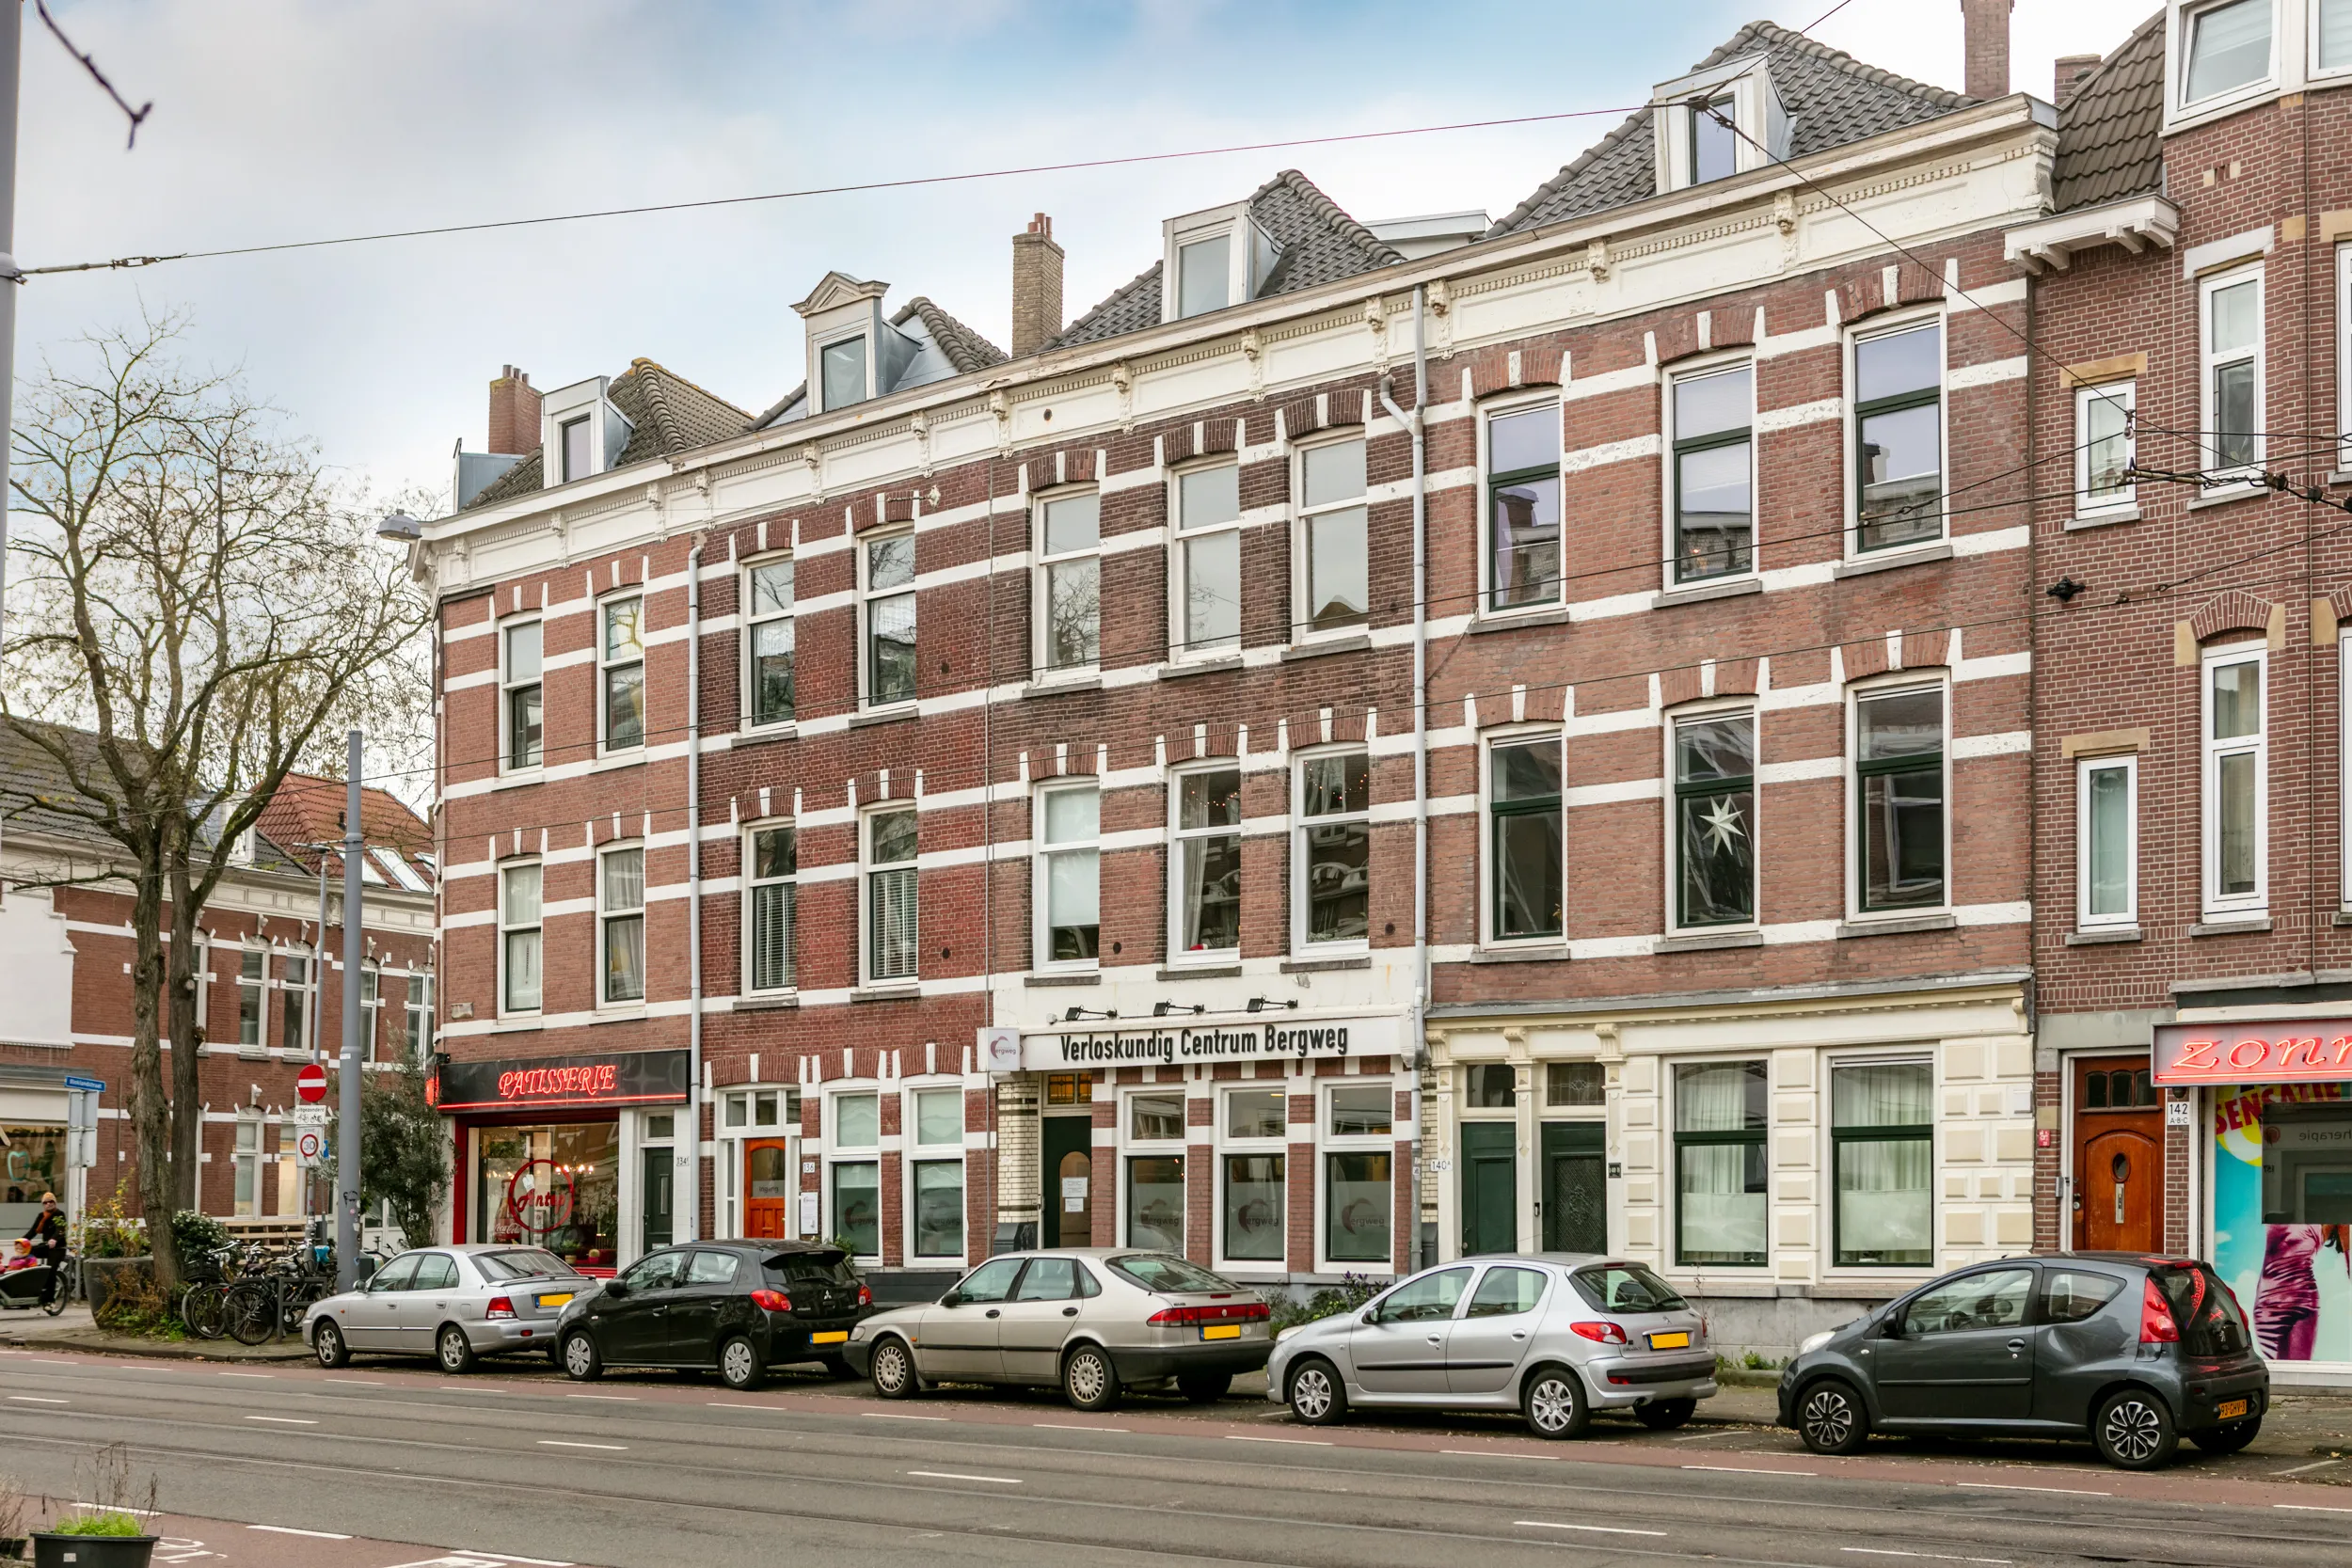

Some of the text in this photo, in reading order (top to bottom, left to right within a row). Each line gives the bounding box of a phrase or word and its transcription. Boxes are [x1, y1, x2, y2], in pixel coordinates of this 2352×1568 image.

[1060, 1024, 1349, 1063] Verloskundig Centrum Bergweg
[499, 1065, 616, 1099] PATISSERIE
[2169, 1102, 2188, 1116] 142
[303, 1140, 316, 1150] 30
[803, 1163, 815, 1172] 136
